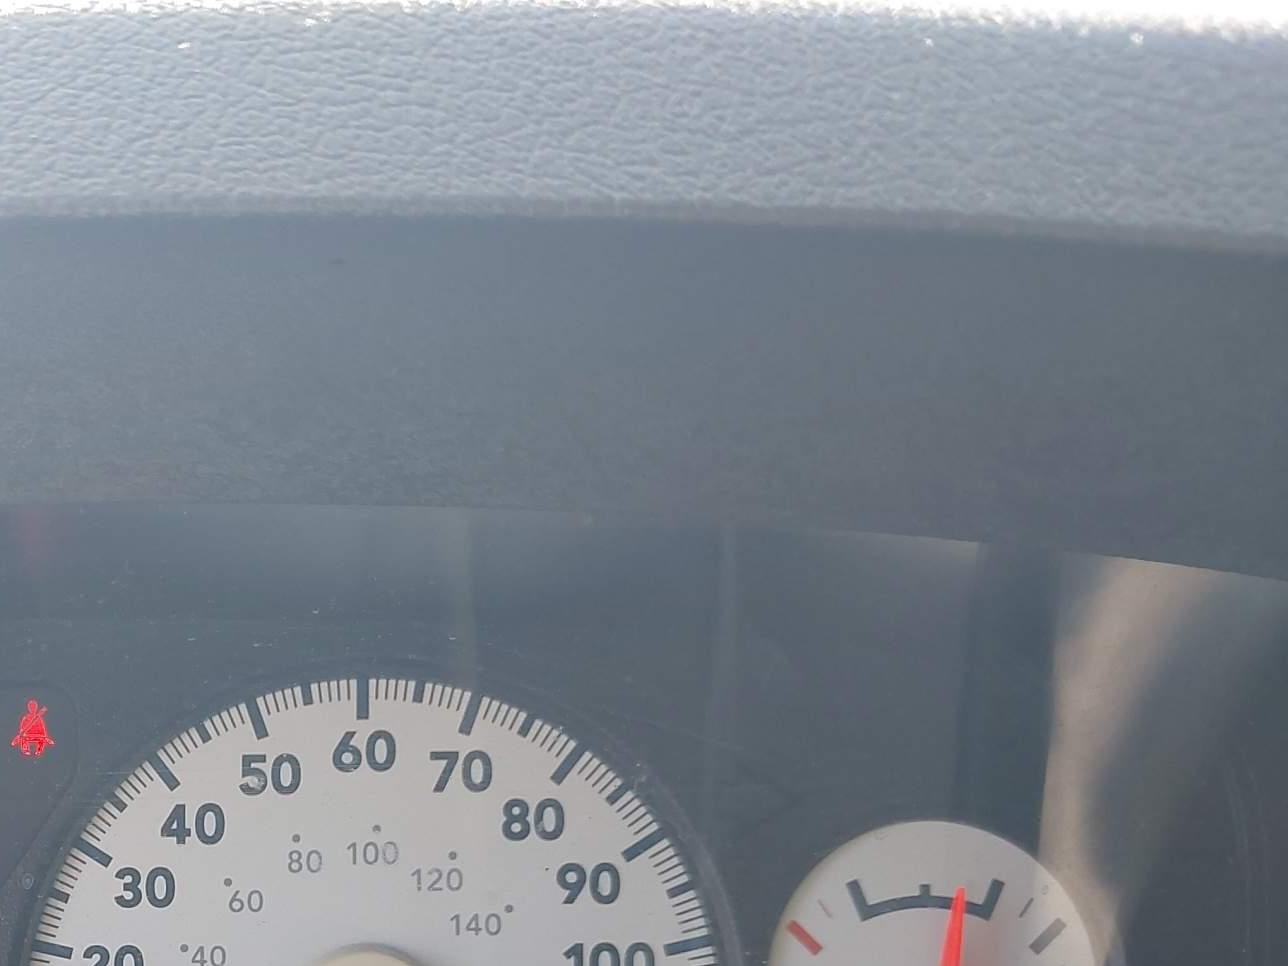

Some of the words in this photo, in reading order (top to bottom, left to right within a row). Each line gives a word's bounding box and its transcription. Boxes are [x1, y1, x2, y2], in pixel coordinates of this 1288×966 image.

[332, 732, 396, 772] 60
[430, 751, 492, 792] 70
[240, 754, 301, 794] 50
[160, 804, 225, 844] 40
[501, 799, 564, 840] 80
[288, 850, 323, 873] 80
[347, 842, 399, 865] 100
[114, 868, 175, 907] 30
[412, 869, 463, 892] 120
[556, 863, 620, 903] 90
[228, 890, 263, 913] 60
[451, 914, 501, 936] 140
